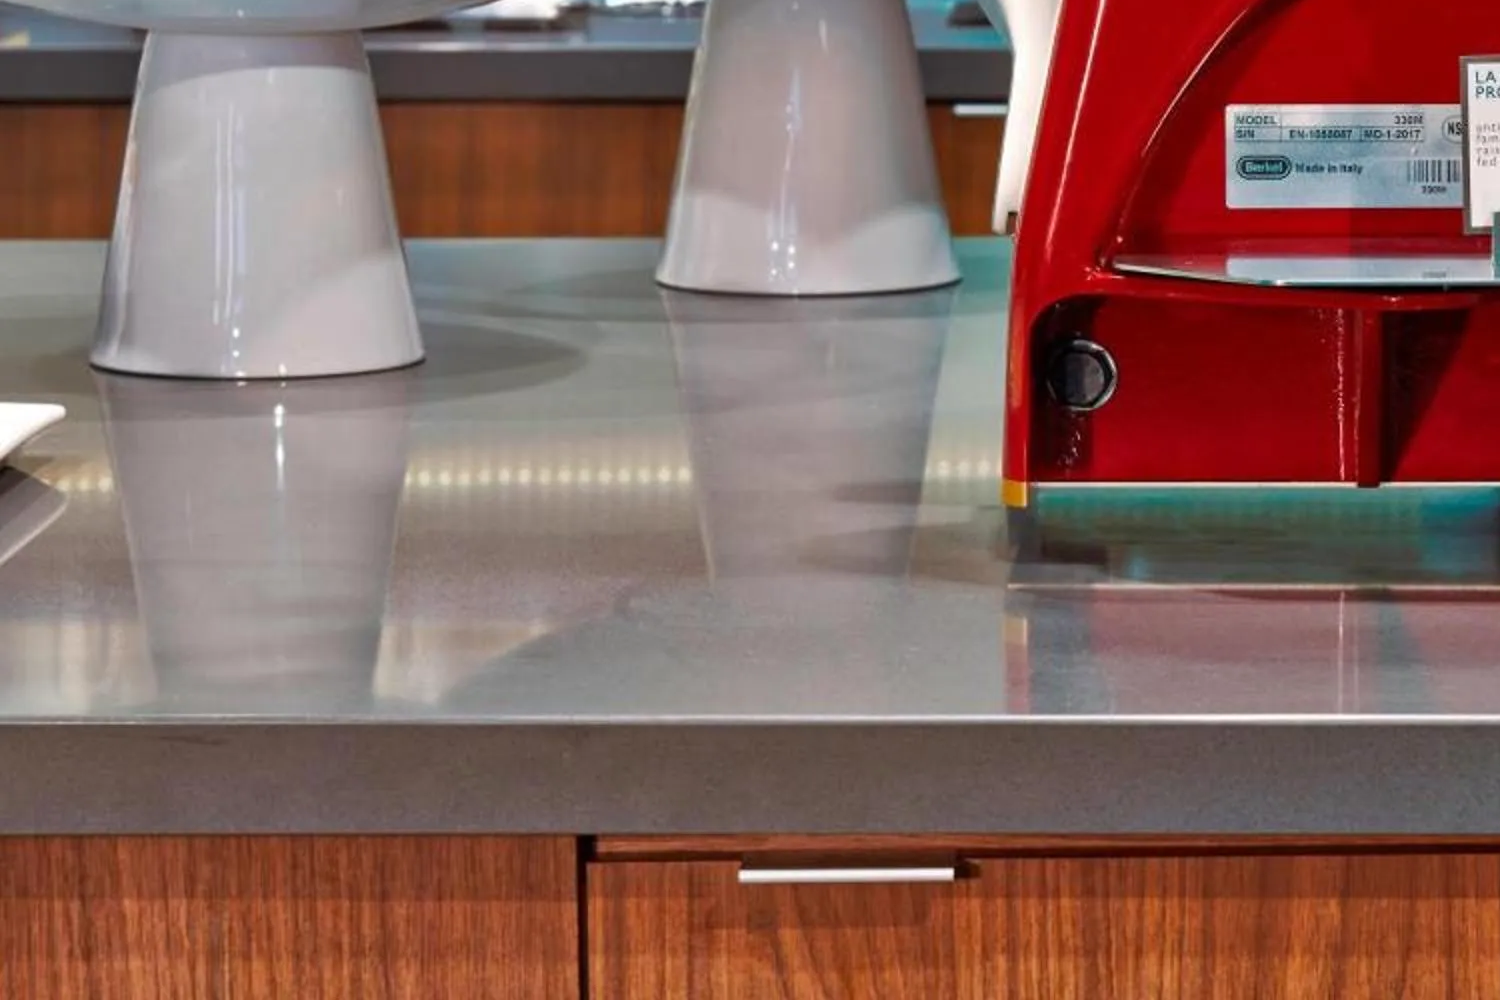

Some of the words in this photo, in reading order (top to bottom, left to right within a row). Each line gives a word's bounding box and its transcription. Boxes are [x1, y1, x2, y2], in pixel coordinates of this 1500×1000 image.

[1475, 71, 1497, 84] LA
[1236, 115, 1277, 125] MODEL
[1447, 121, 1463, 136] NS
[1477, 156, 1498, 167] fed
[1296, 163, 1325, 173] Made
[1328, 163, 1338, 173] in
[1340, 163, 1363, 175] Italy
